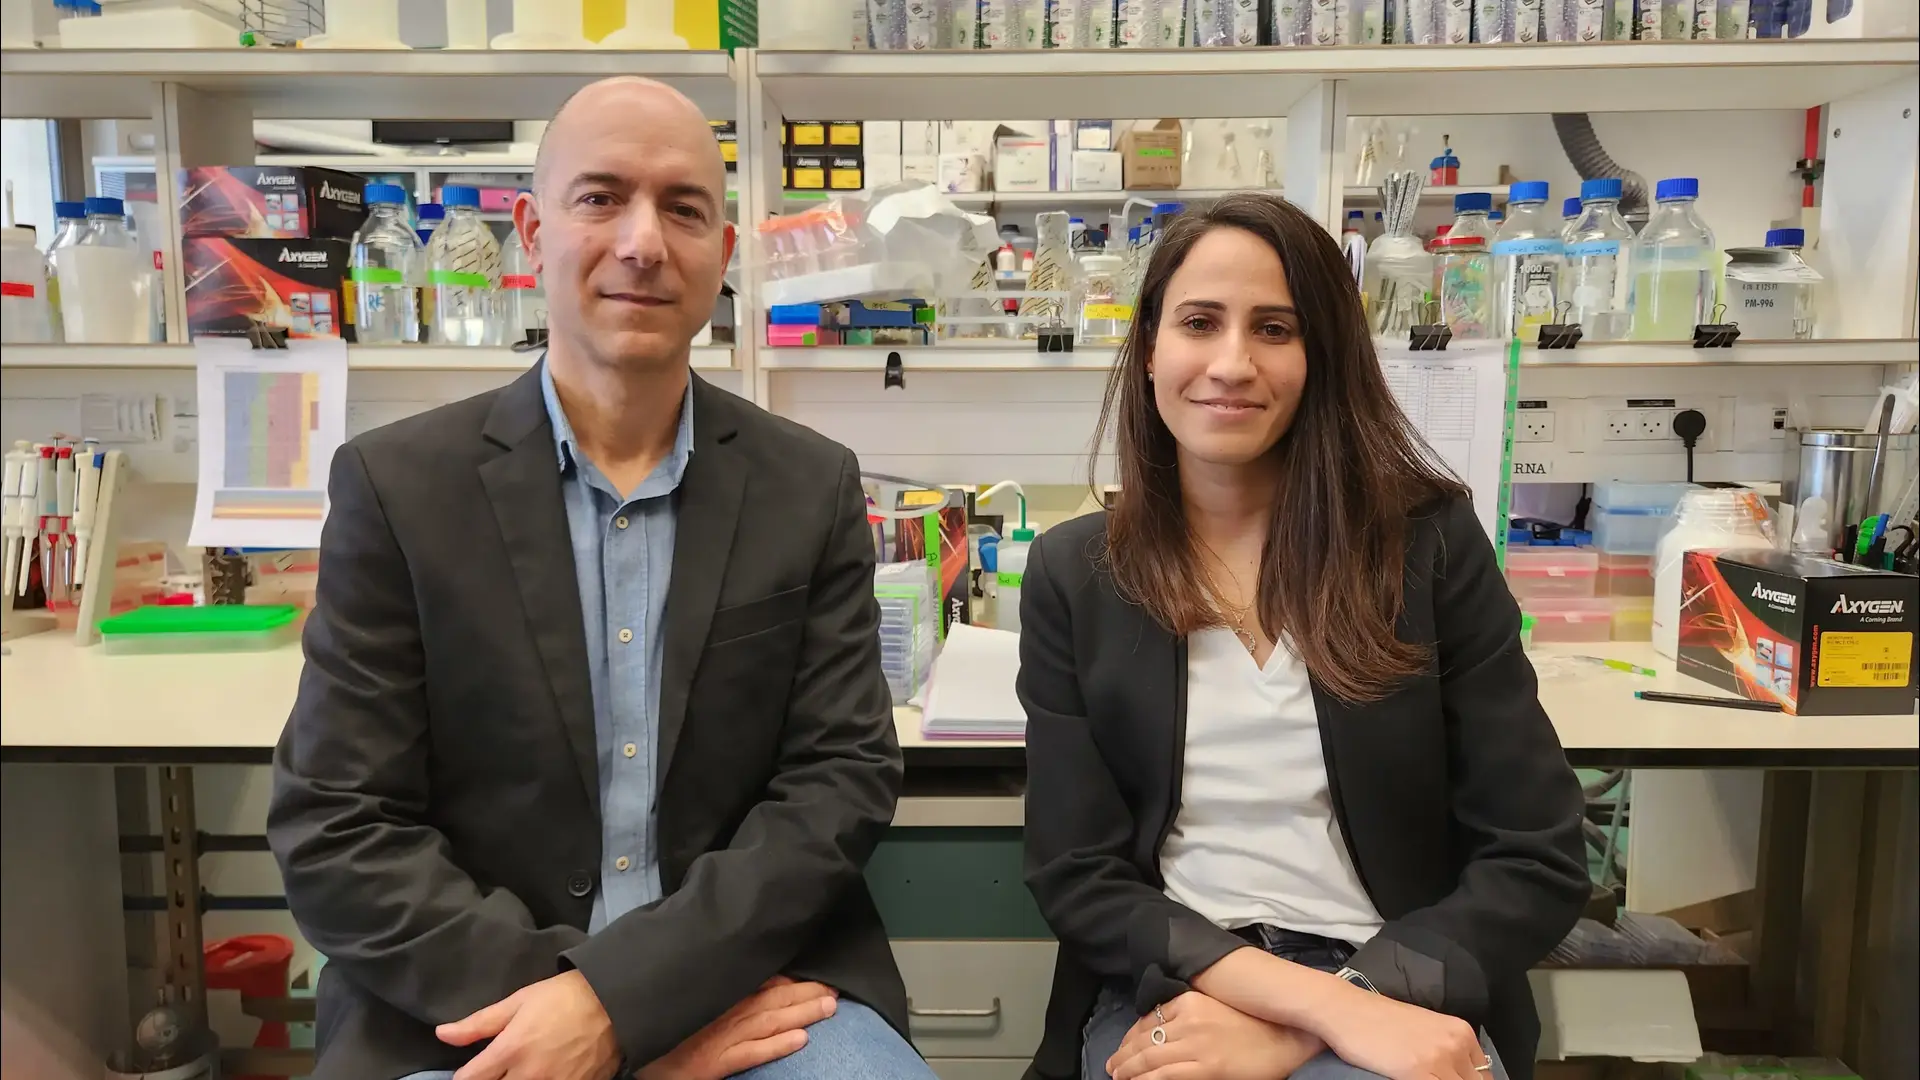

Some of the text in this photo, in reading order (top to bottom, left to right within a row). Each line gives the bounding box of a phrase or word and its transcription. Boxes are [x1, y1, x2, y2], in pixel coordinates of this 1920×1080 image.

[257, 172, 296, 186] AXYGEN
[320, 180, 361, 205] AXYGEN
[278, 246, 328, 262] AXYGEN
[1519, 264, 1542, 274] 1000
[1745, 299, 1774, 308] PM-996
[1514, 463, 1546, 474] RNA
[1751, 581, 1797, 606] AXYGEN
[1830, 594, 1905, 614] AXYGEN
[1865, 616, 1887, 624] Corning
